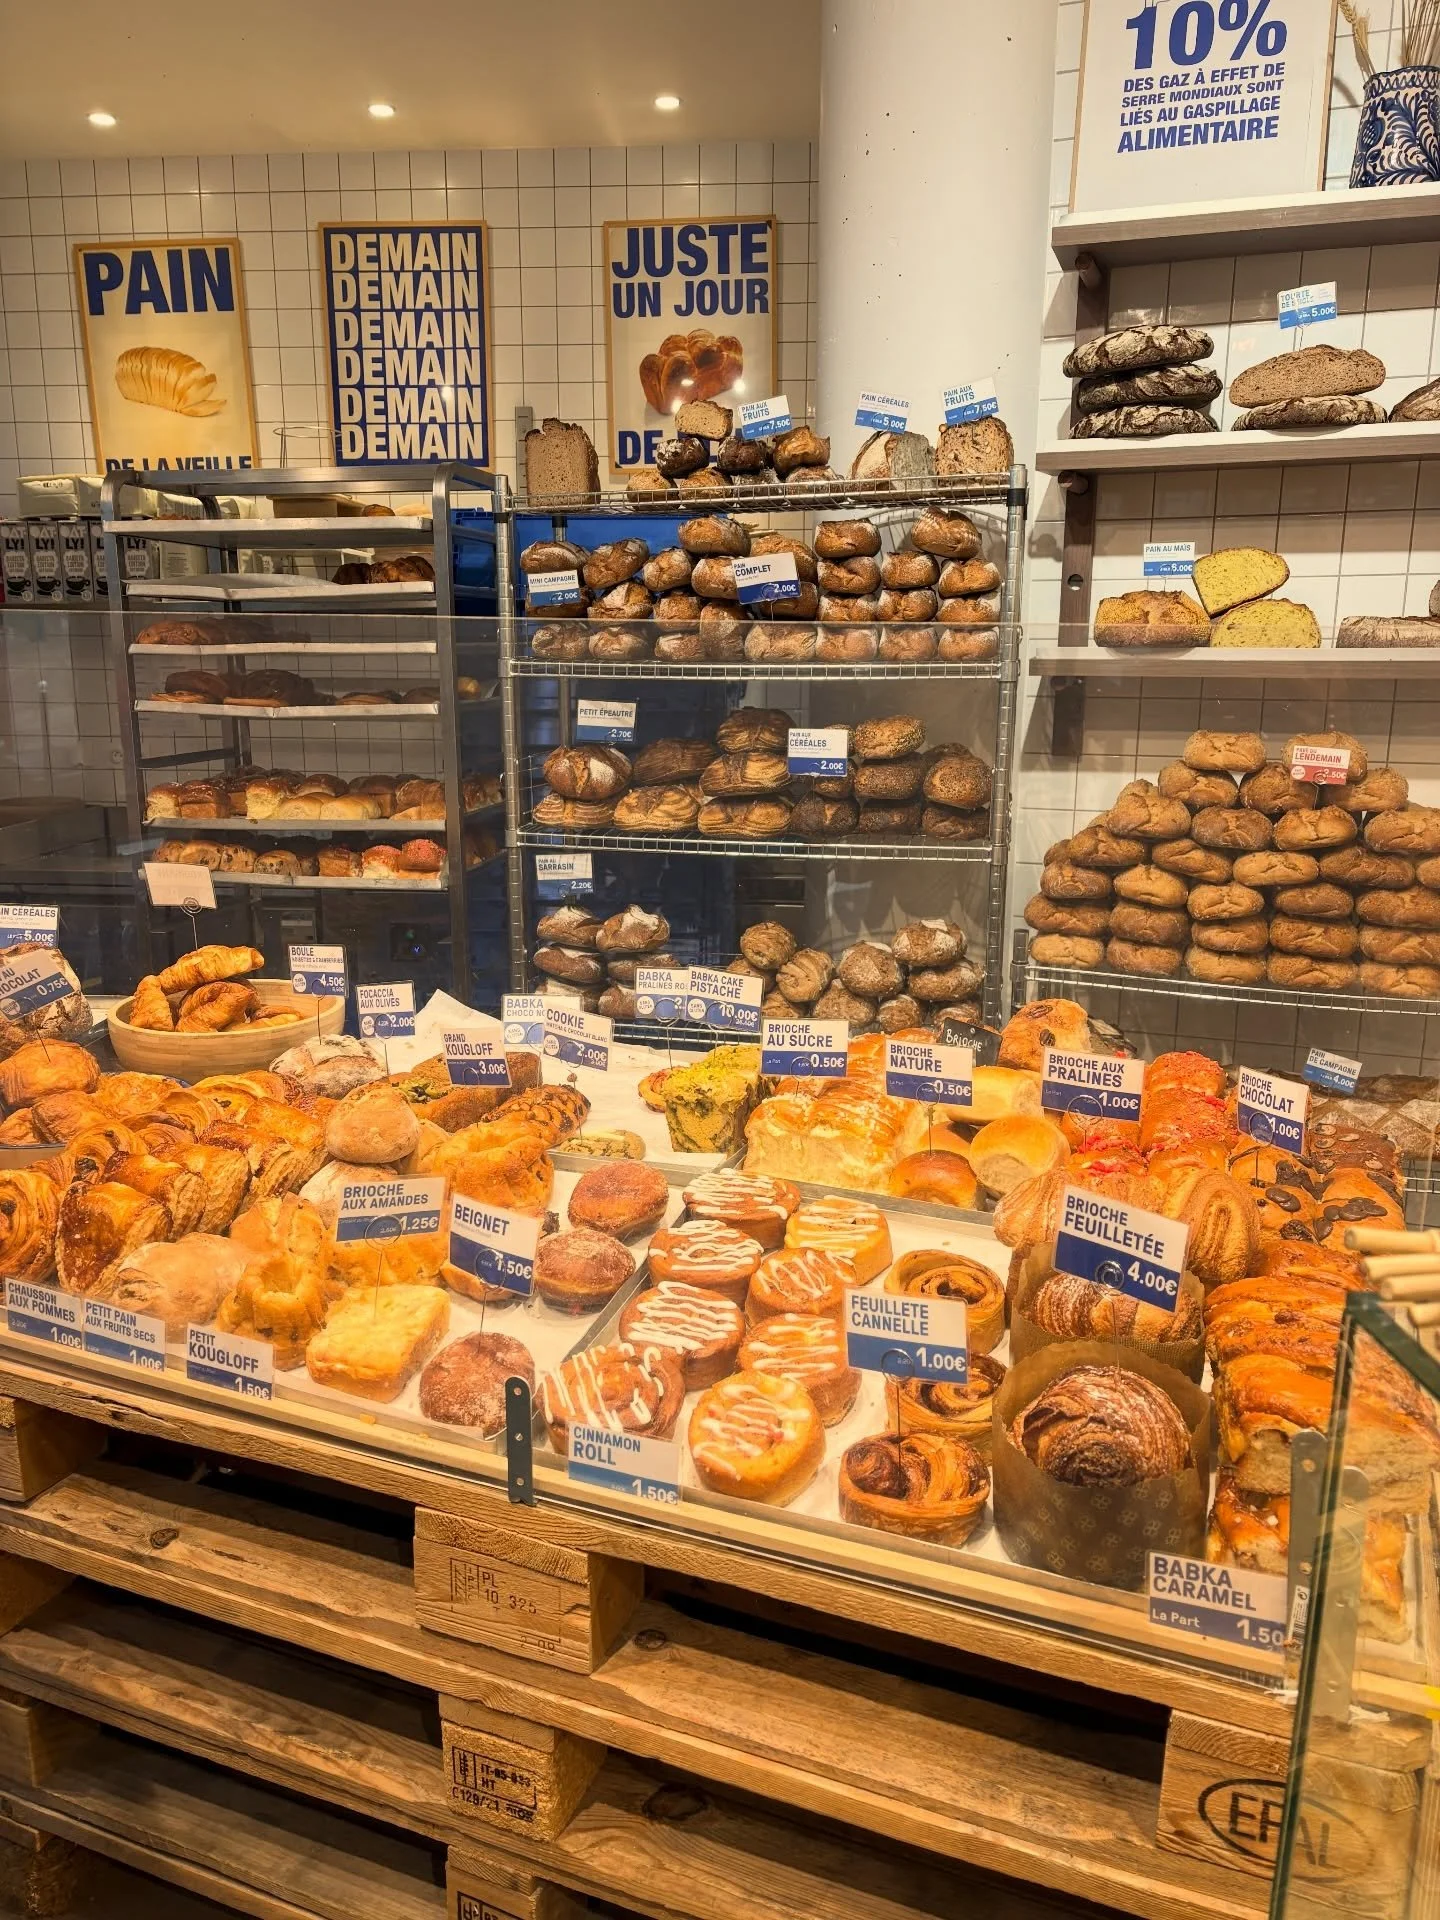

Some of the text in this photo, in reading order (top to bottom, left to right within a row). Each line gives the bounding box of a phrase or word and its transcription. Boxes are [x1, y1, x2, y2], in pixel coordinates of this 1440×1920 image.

[1126, 0, 1288, 70] 10%
[1124, 62, 1286, 93] DES GAZ À EFFET DE
[1122, 79, 1285, 108] SERRE MONDIAUX SONT
[1120, 96, 1281, 126] LIÉS AU GASPILLAGE
[1117, 116, 1280, 153] ALIMENTAIRE
[330, 233, 478, 272] DEMAIN
[612, 223, 769, 278] JUSTE
[83, 248, 235, 316] PAIN
[332, 271, 479, 310] DEMAIN
[612, 278, 770, 318] UN JOUR
[1312, 306, 1336, 317] 5.00€
[334, 310, 480, 348] DEMAIN
[336, 348, 482, 386] DEMAIN
[944, 384, 972, 398] PAIN AUX
[945, 392, 975, 406] FRUITS
[339, 386, 483, 424] DEMAIN
[742, 401, 768, 412] PAIN AUX
[877, 396, 910, 408] CÉRÉALES
[742, 408, 770, 422] FRUITS
[770, 418, 790, 430] 7.50€
[342, 424, 484, 460] DEMAIN
[6, 538, 24, 550] LY!
[35, 538, 55, 550] LY!
[65, 538, 84, 550] LY!
[544, 574, 576, 584] CAMPAGNE
[735, 564, 772, 576] COMPLET
[774, 584, 796, 592] 2.00€
[580, 708, 598, 716] PETIT
[600, 708, 633, 718] ÉPEAUTRE
[790, 737, 827, 748] CÉRÉALES
[820, 760, 844, 770] 2.00€
[1295, 752, 1342, 764] LENDEMAIN
[571, 880, 592, 889] 2.20€
[12, 906, 56, 918] CÉRÉALES
[24, 930, 54, 942] 5.00€
[292, 947, 314, 956] BOULE
[2, 968, 16, 979] AU
[320, 974, 345, 986] 4.50€
[638, 971, 672, 982] BABKA
[691, 970, 744, 988] BABKA CAKE
[36, 978, 68, 996] 0.75€
[360, 988, 394, 999] FOCACCIA
[638, 981, 673, 990] PRALINES
[690, 980, 742, 1000] PISTACHE
[360, 998, 400, 1009] AUX OLIVES
[506, 998, 544, 1008] BABKA
[546, 1008, 584, 1030] COOKIE
[719, 1004, 758, 1022] 10.00€
[768, 1024, 811, 1034] BRIOCHE
[444, 1034, 466, 1043] GRAND
[766, 1034, 833, 1048] AU SUCRE
[446, 1043, 493, 1056] KOUGLOFF
[890, 1044, 933, 1058] BRIOCHE
[1311, 1049, 1326, 1058] PAIN
[479, 1060, 506, 1075] 3.00€
[810, 1054, 845, 1068] 0.50€
[890, 1054, 942, 1072] NATURE
[1050, 1054, 1125, 1074] BRIOCHE AUX
[1310, 1056, 1357, 1076] DE CAMPAGNE
[1048, 1064, 1122, 1088] PRALINES
[1242, 1072, 1272, 1092] BRIOCHE
[1333, 1075, 1355, 1088] 4.00€
[934, 1080, 972, 1097] 0.50€
[1098, 1092, 1139, 1110] 1.00€
[1240, 1085, 1294, 1114] CHOCOLAT
[1268, 1116, 1300, 1140] 1.00€
[344, 1184, 404, 1198] BRIOCHE
[341, 1194, 429, 1211] AUX AMANDES
[1066, 1194, 1128, 1226] BRIOCHE
[400, 1215, 439, 1234] 1.25€
[454, 1203, 510, 1236] BEIGNET
[1064, 1210, 1165, 1260] FEUILLETÉE
[494, 1252, 532, 1280] 1.50€
[1127, 1260, 1178, 1296] 4.00€
[8, 1282, 57, 1306] CHAUSSON
[8, 1294, 76, 1323] AUX POMMES
[86, 1302, 137, 1327] PETIT PAIN
[852, 1295, 929, 1320] FEUILLETE
[86, 1315, 156, 1344] AUX FRUITS SECS
[852, 1312, 929, 1336] CANNELLE
[50, 1326, 81, 1348] 1.00€
[190, 1329, 216, 1346] PETIT
[129, 1350, 163, 1370] 1.00€
[189, 1342, 259, 1374] KOUGLOFF
[916, 1346, 966, 1372] 1.00€
[234, 1377, 270, 1400] 1.50€
[574, 1426, 641, 1452] CINNAMON
[574, 1441, 616, 1466] ROLL
[632, 1478, 678, 1504] 1.50€
[482, 1570, 498, 1588] PL
[1154, 1556, 1233, 1588] BABKA
[484, 1588, 498, 1604] 10
[1154, 1576, 1257, 1612] CARAMEL
[1152, 1608, 1200, 1628] La Part
